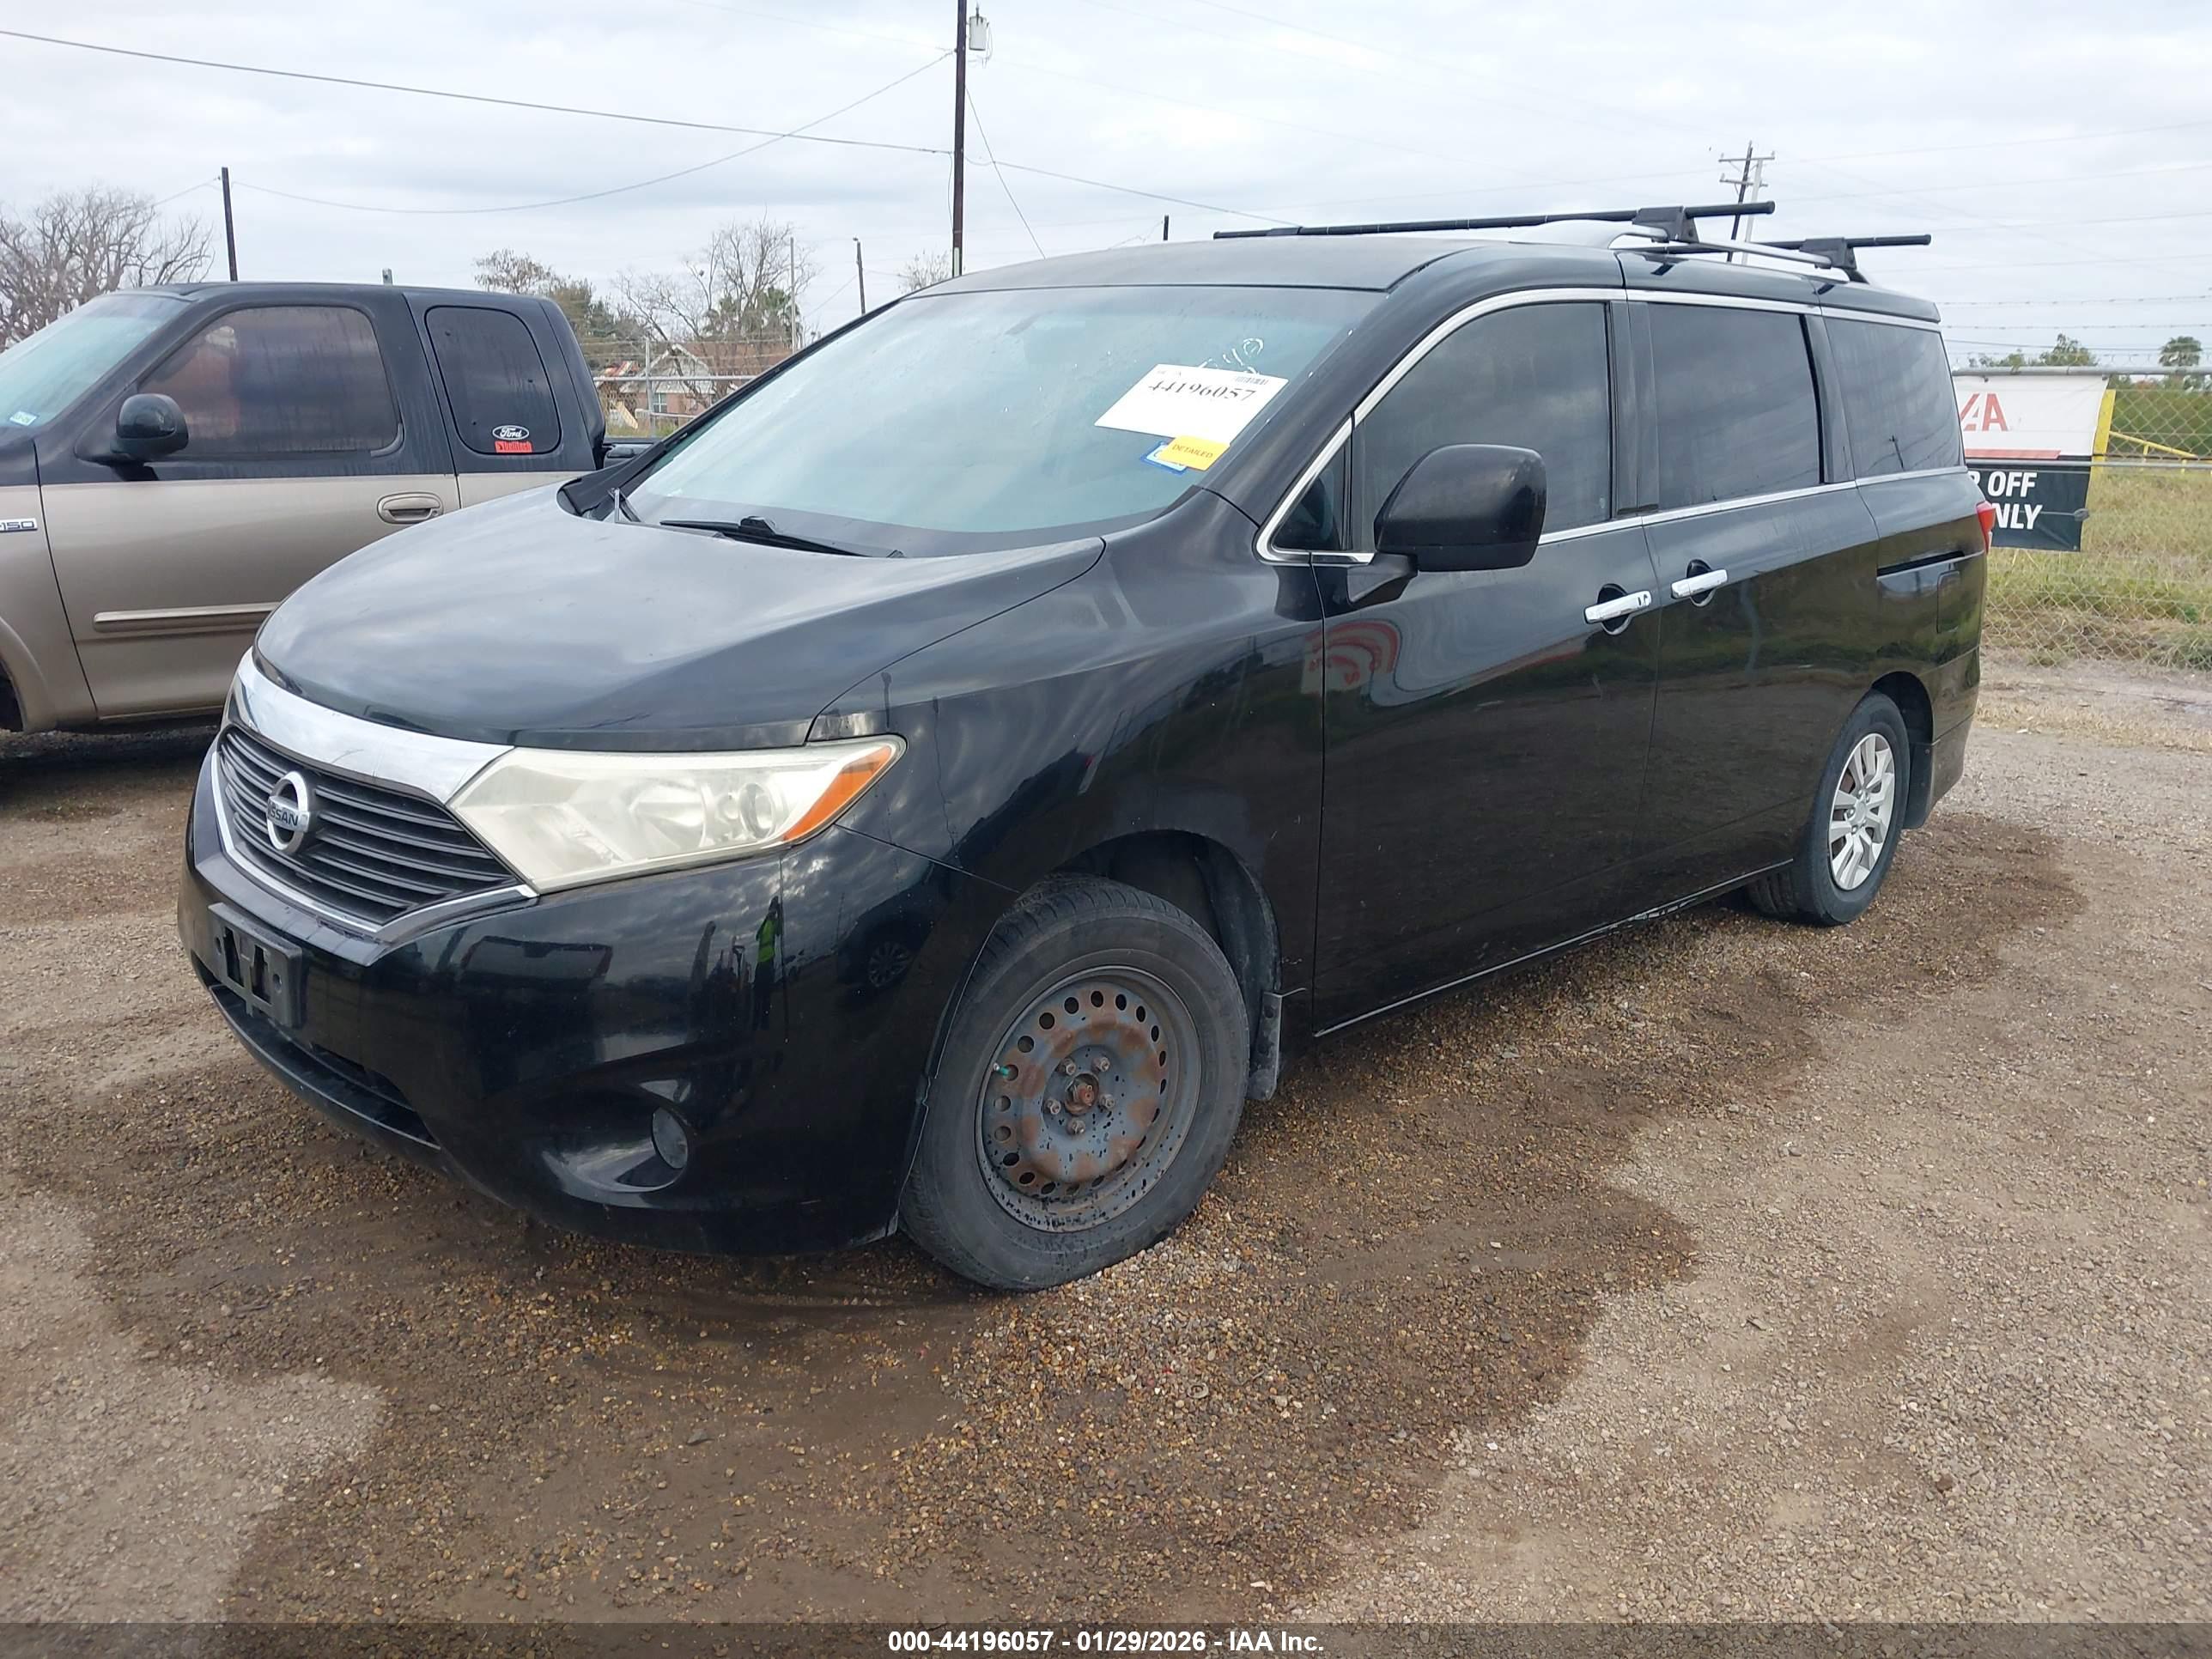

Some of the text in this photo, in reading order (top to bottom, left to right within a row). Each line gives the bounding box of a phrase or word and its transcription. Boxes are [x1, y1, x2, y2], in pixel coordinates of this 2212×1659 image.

[1148, 380, 1256, 402] 44196057
[500, 427, 522, 438] Ford
[1171, 443, 1214, 459] DETAILED
[1987, 471, 2038, 497] OFF
[1991, 502, 2043, 530] NLY
